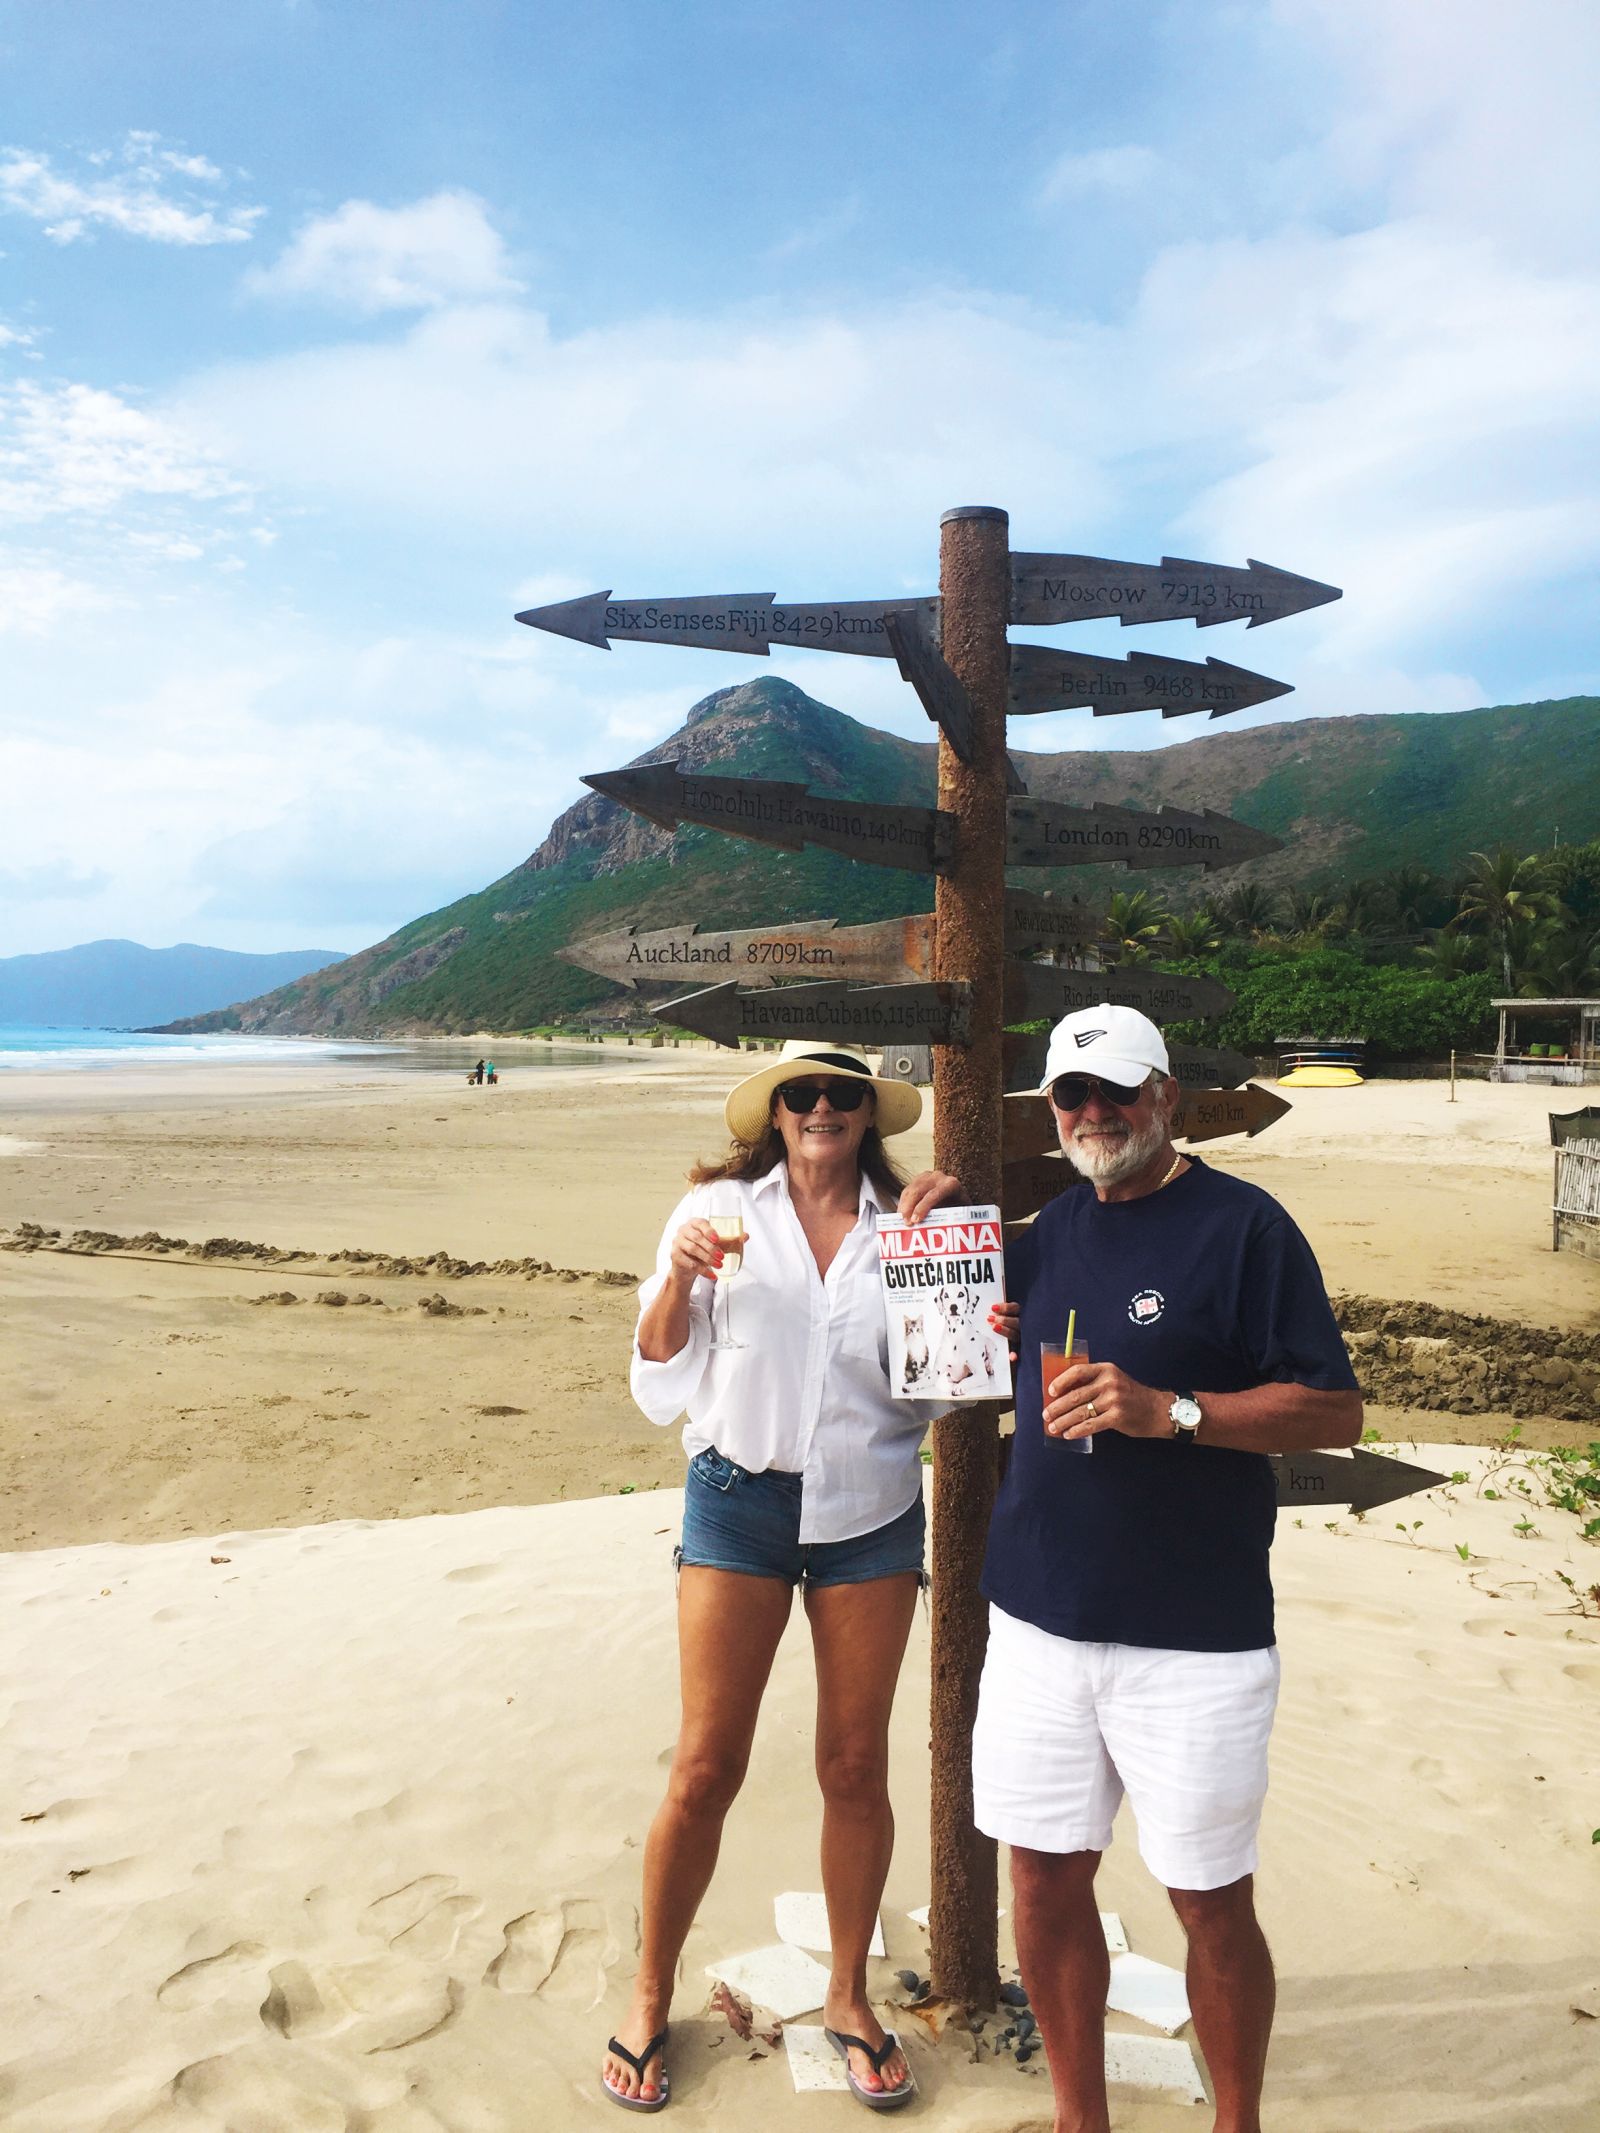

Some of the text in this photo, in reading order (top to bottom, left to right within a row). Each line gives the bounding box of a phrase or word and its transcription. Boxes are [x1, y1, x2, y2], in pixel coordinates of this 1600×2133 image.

[1043, 578, 1264, 609] Moscow 7913 km
[1061, 672, 1236, 700] Berlin 9468 km
[680, 780, 774, 822] Honolulu
[1043, 822, 1129, 847] London
[626, 941, 731, 964] Auckland
[1063, 985, 1083, 1007] Rio
[1085, 986, 1100, 1007] de
[1197, 1103, 1224, 1124] 5640
[878, 1224, 1001, 1258] MLADINA
[885, 1257, 995, 1289] ČUTEČA BITJA
[1289, 1467, 1325, 1490] km
